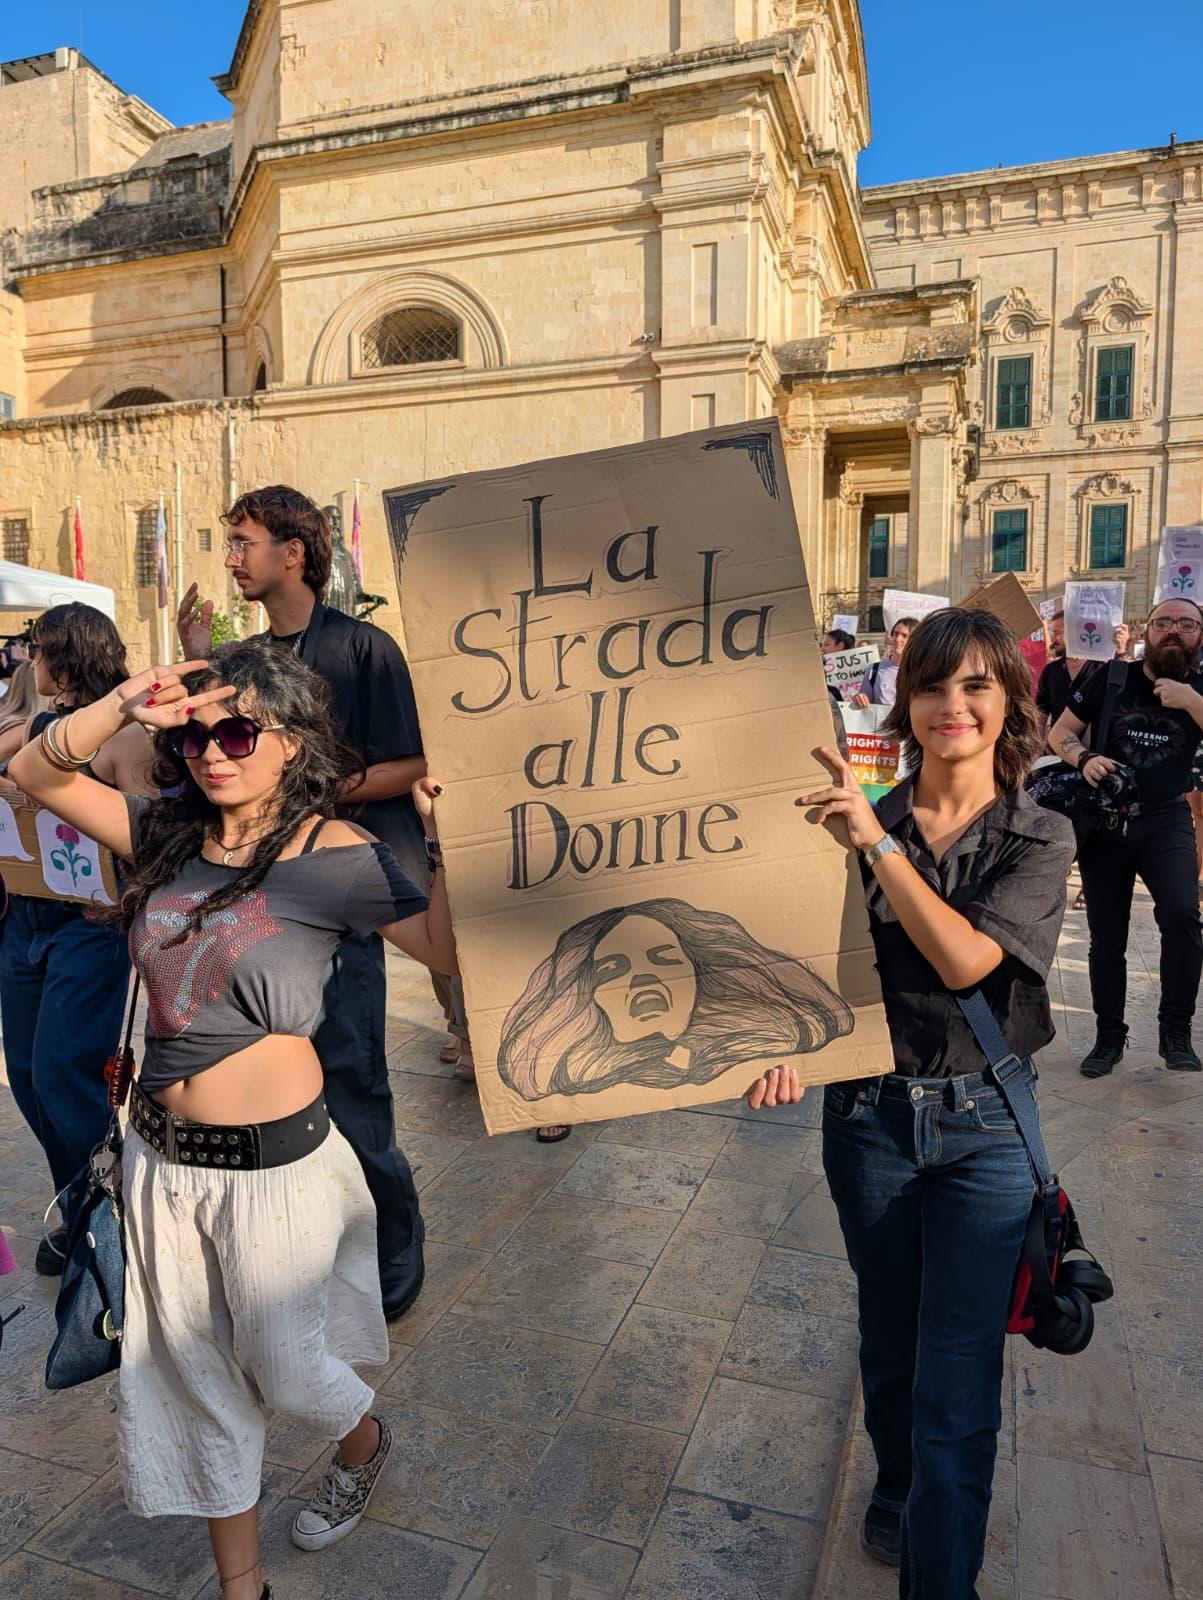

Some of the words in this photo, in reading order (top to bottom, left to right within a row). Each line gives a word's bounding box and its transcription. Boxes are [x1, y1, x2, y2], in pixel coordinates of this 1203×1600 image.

[524, 494, 661, 598] La
[450, 548, 775, 714] Strada
[836, 650, 873, 669] JUST
[834, 672, 848, 681] TO
[849, 669, 867, 678] HAV
[523, 686, 682, 791] alle
[846, 737, 890, 750] RIGHTS
[1127, 729, 1169, 742] INFERNO
[850, 754, 896, 767] RIGHTS
[504, 801, 745, 890] Donne
